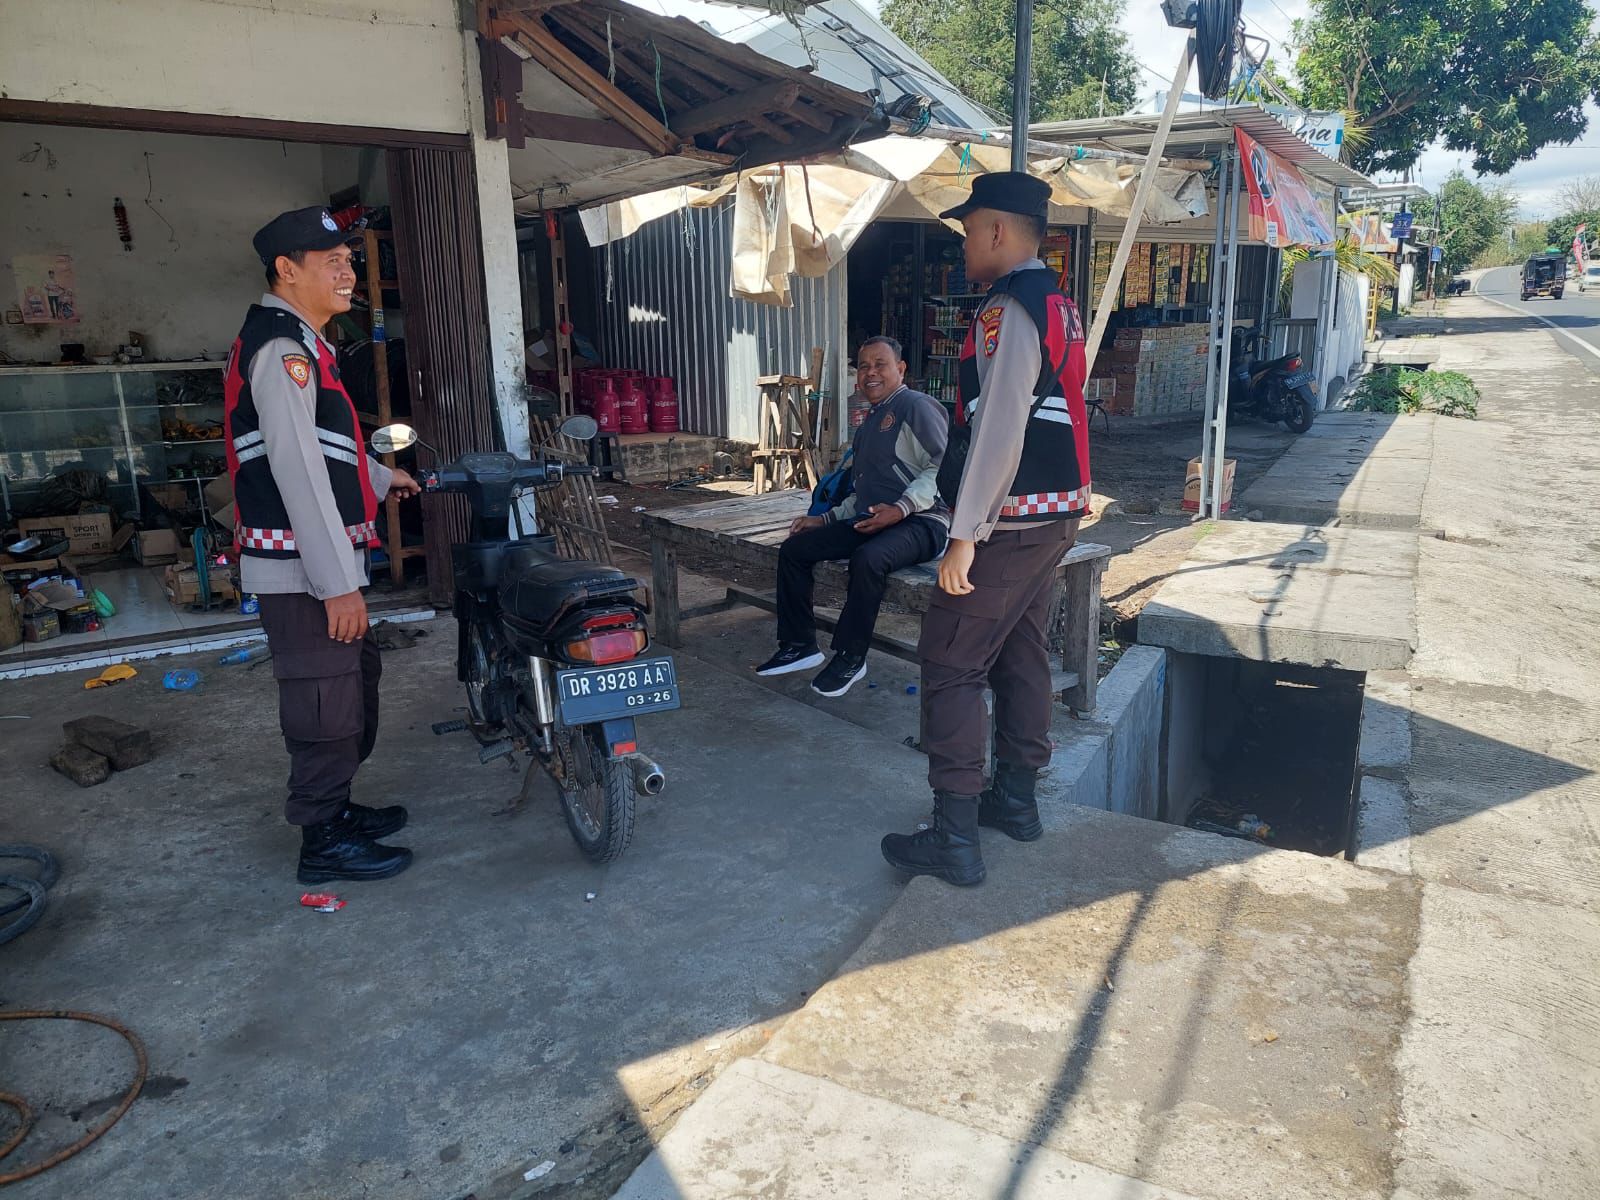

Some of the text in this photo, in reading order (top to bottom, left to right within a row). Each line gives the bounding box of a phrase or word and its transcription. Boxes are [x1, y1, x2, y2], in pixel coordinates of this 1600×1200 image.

[72, 525, 99, 533] SPORT
[569, 667, 665, 696] DR 3928 AA
